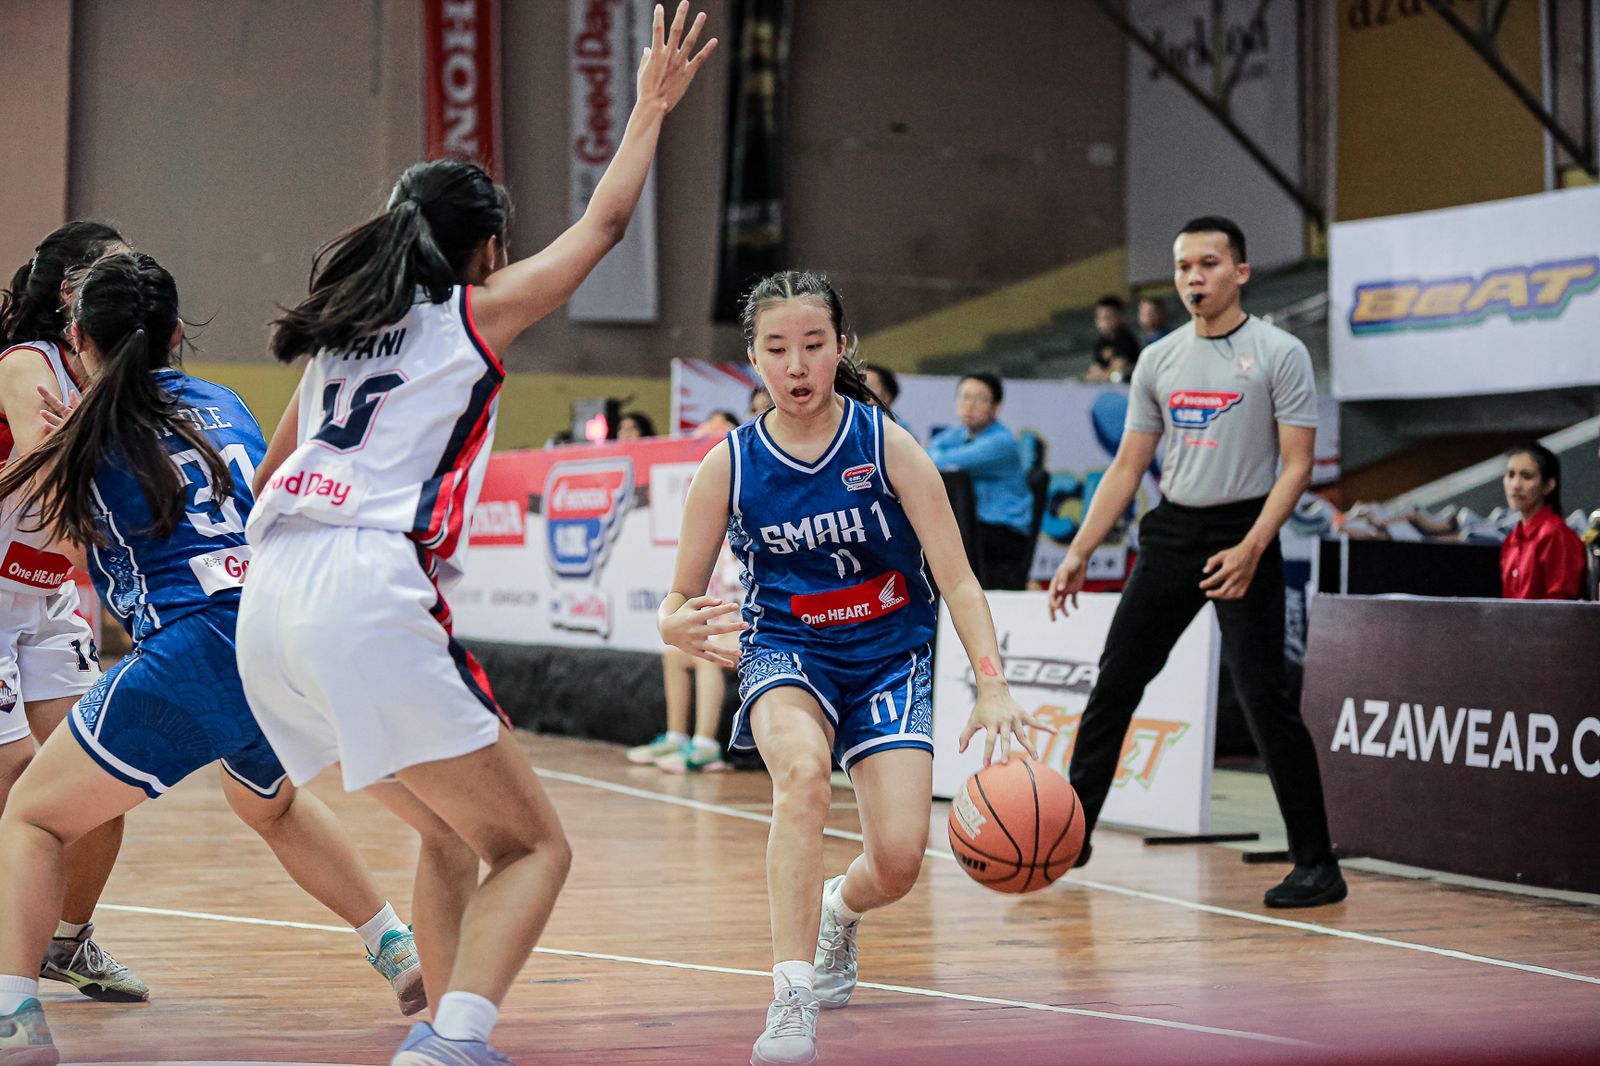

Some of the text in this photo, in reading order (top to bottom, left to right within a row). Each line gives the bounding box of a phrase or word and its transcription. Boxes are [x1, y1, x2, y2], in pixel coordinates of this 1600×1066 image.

[303, 473, 352, 506] Day
[870, 500, 893, 541] 1
[8, 562, 32, 580] One
[830, 548, 861, 579] 11
[801, 596, 905, 625] One HEART. HONDA
[868, 690, 899, 726] 11
